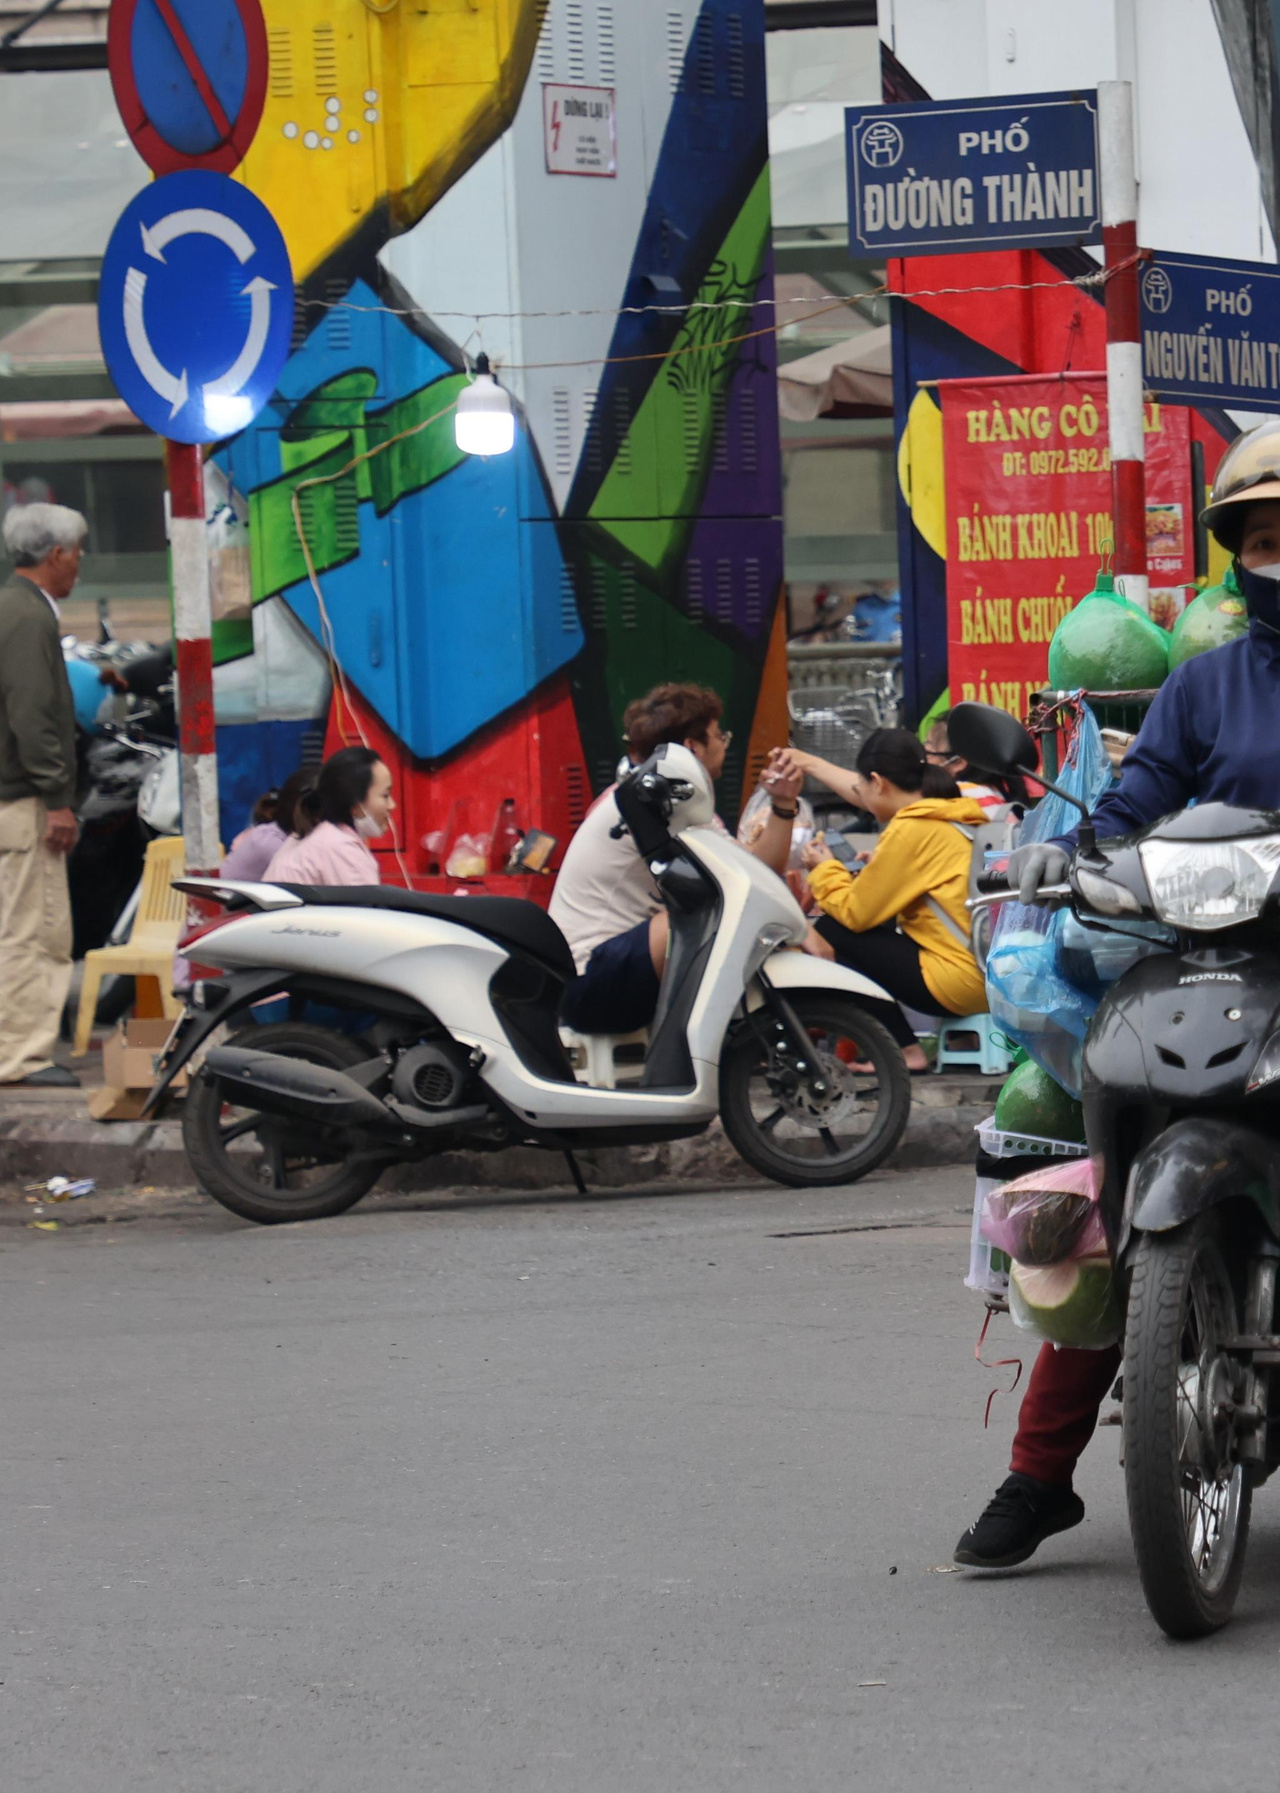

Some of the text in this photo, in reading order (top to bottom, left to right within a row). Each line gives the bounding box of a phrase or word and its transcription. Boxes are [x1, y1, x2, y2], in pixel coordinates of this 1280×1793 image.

[958, 116, 1030, 156] PHỐ
[863, 161, 1094, 233] ĐƯỜNG THÀNH
[1205, 283, 1252, 317] PHỐ
[1144, 322, 1224, 385] NGUYỄN
[1227, 330, 1267, 389] VĂN
[965, 399, 1052, 443] HÀNG
[1059, 393, 1099, 438] CÔ
[1002, 452, 1027, 477] ĐT:
[956, 502, 1014, 562] BÁNH
[1016, 510, 1080, 561] KHOAI
[959, 585, 1015, 645] BÁNH
[1178, 971, 1243, 985] HONDA
